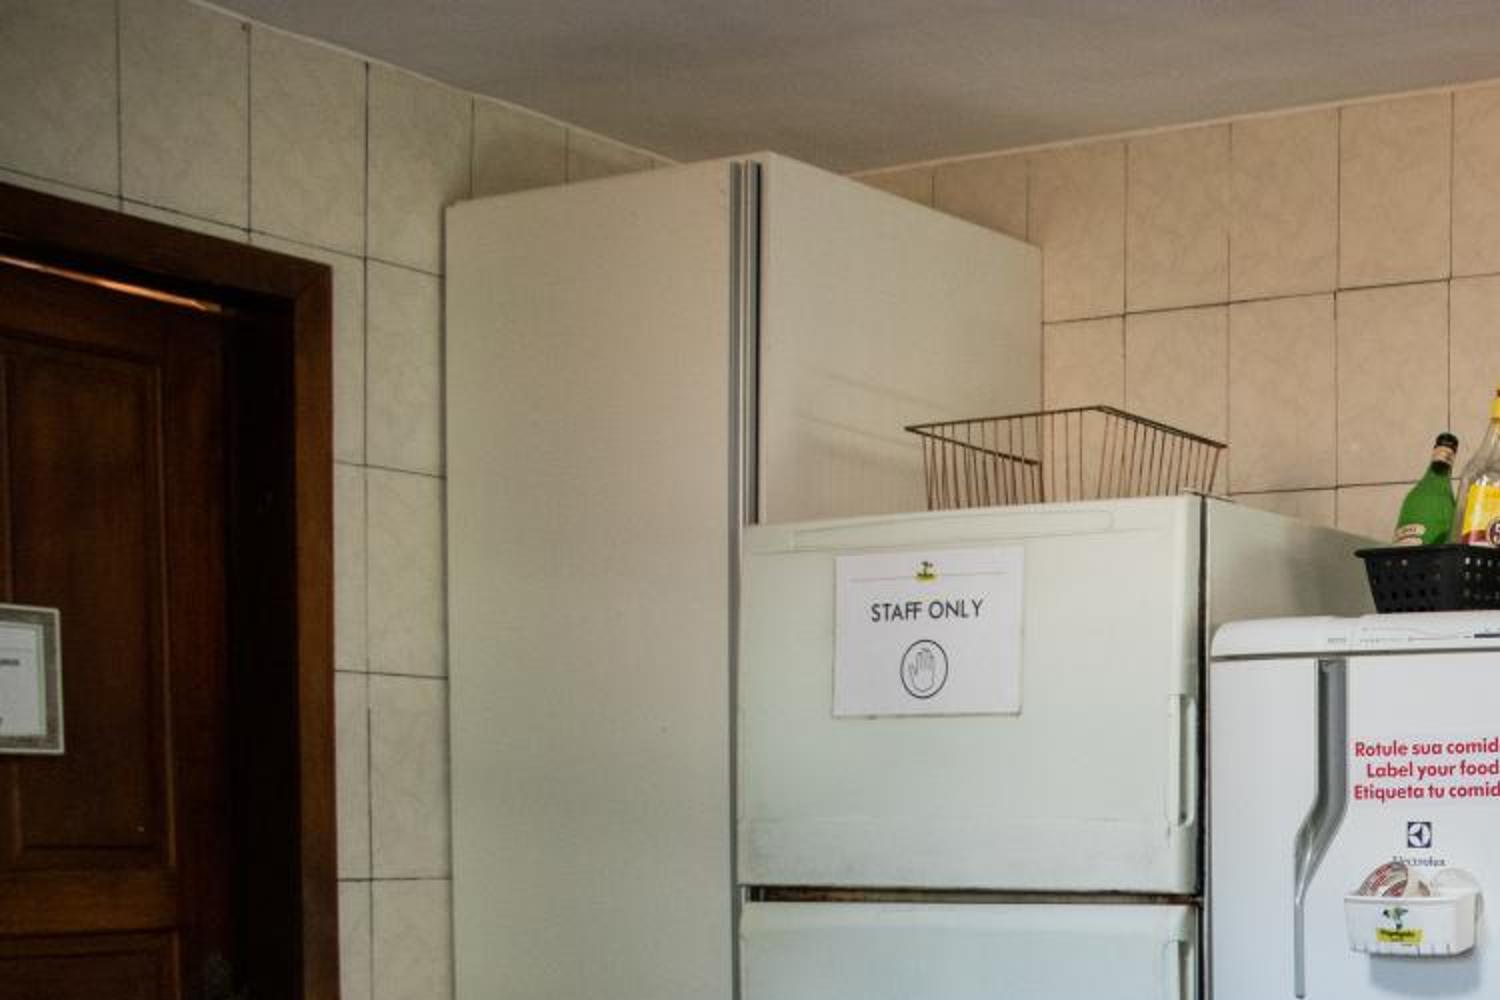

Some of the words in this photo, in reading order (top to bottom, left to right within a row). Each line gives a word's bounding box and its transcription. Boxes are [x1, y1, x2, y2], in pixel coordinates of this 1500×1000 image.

[871, 602, 923, 622] STAFF
[928, 599, 983, 619] ONLY
[1355, 740, 1408, 757] Rotule
[1412, 744, 1442, 755] sua
[1367, 762, 1413, 778] Label
[1417, 765, 1456, 780] your
[1460, 760, 1500, 775] food
[1354, 783, 1424, 803] Etiqueta
[1428, 785, 1445, 798] tu
